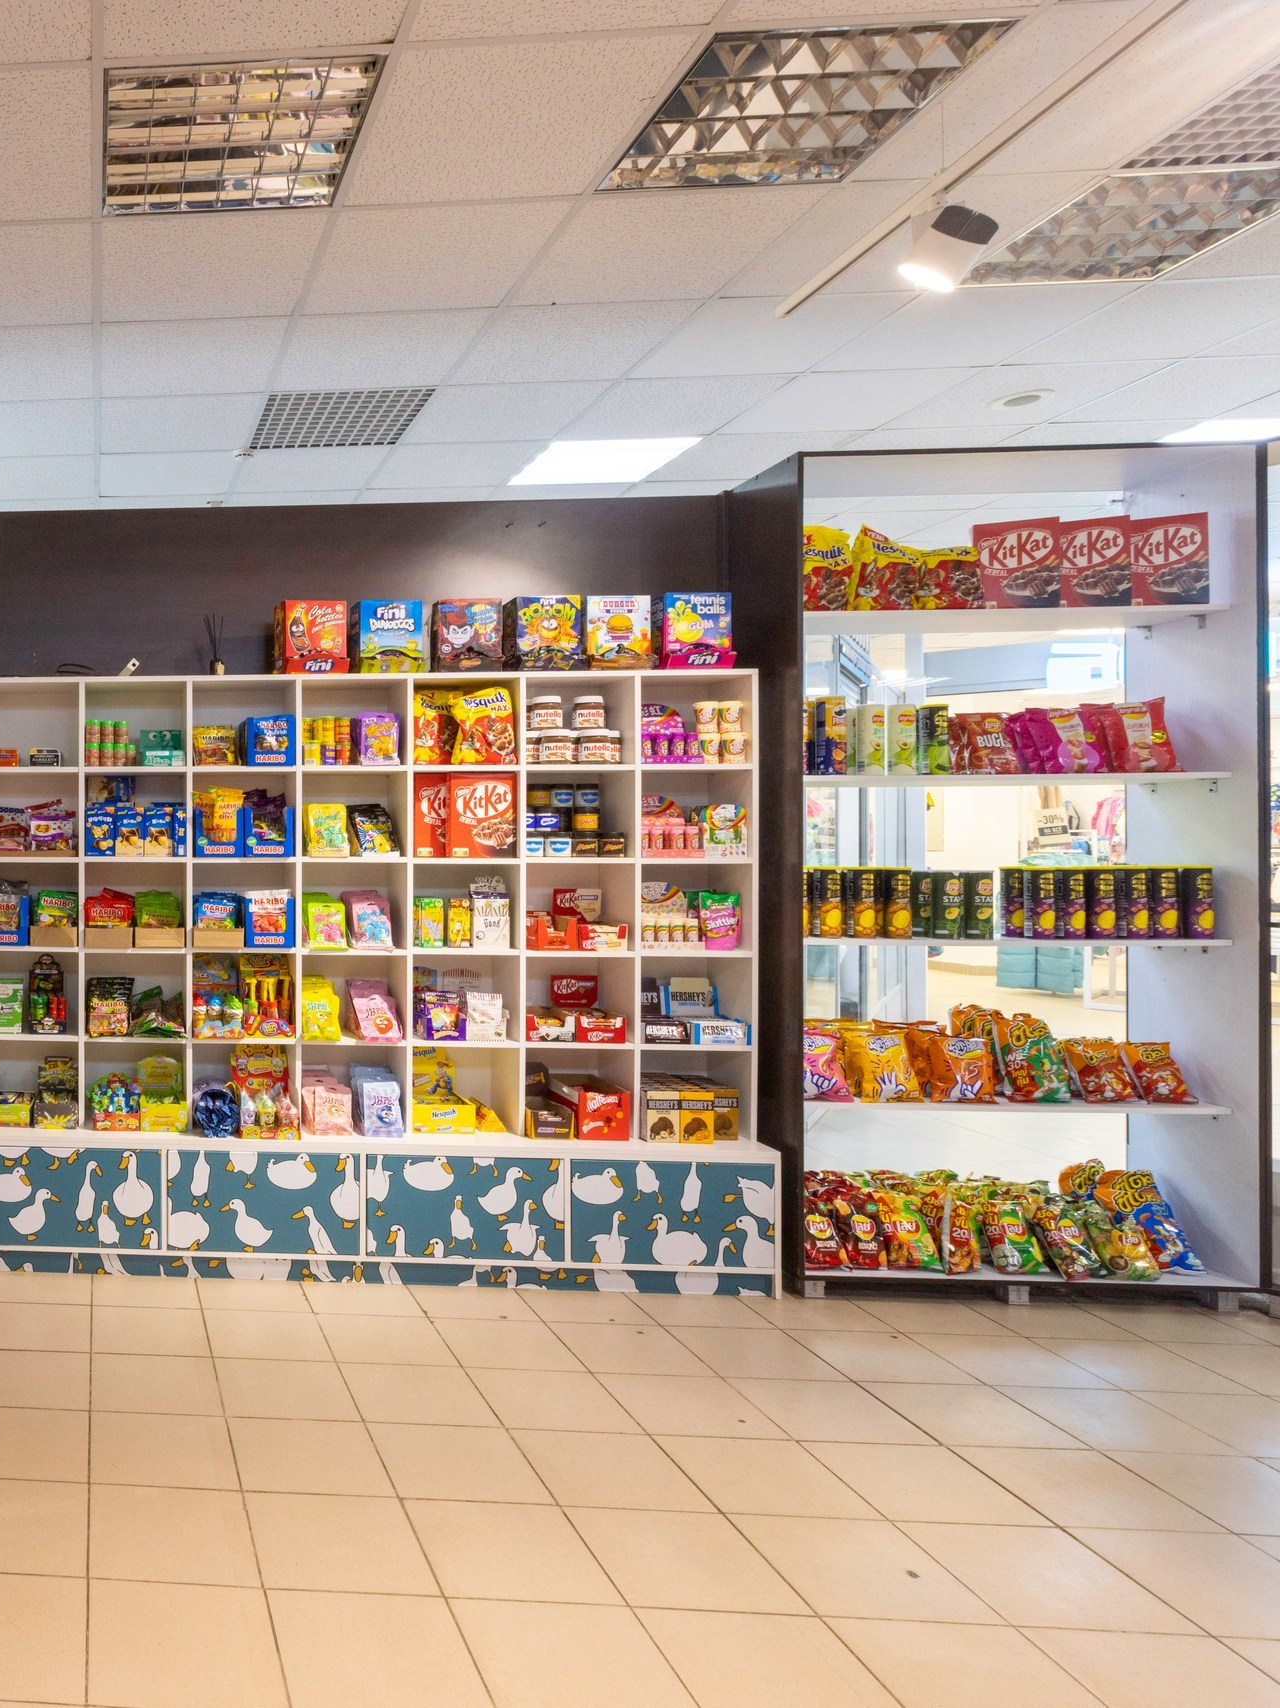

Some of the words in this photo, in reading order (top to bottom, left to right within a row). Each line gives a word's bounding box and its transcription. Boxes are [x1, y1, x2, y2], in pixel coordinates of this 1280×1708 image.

[988, 531, 1050, 568] KitKat
[1134, 528, 1198, 564] KitKat
[984, 569, 1008, 577] CEREAL
[603, 600, 636, 608] BURGER
[690, 595, 726, 605] tennis
[307, 605, 333, 620] Cola
[376, 606, 406, 619] Fini
[697, 604, 726, 614] balls
[688, 620, 714, 630] GUM
[687, 652, 719, 665] Fini
[305, 659, 333, 671] Fini
[535, 710, 562, 719] nutella
[577, 710, 604, 719] nutella
[259, 721, 288, 729] HARIBO
[544, 744, 571, 753] nutella
[583, 744, 612, 753] nutella
[255, 754, 286, 763] HARIBO
[463, 784, 509, 817] KitKat
[424, 816, 442, 825] CEREAL
[459, 816, 478, 826] CEREAL
[1038, 814, 1064, 824] -30%
[204, 846, 235, 854] HARIBO
[253, 846, 285, 854] HARIBO
[42, 898, 74, 907] HARIBO
[253, 898, 285, 906] HARIBO
[559, 893, 581, 907] KitKat
[91, 908, 124, 916] HARIBO
[203, 904, 234, 913] HARIBO
[555, 979, 577, 994] KitKat
[671, 992, 705, 1001] HERSHEY'S
[646, 1025, 677, 1035] HERSHEY'S
[1007, 1061, 1027, 1070] 30%
[1012, 1068, 1027, 1077] ใหญ่
[1017, 1075, 1029, 1086] คุ้ม
[648, 1100, 678, 1109] HERSHEY'S
[682, 1101, 712, 1110] HERSHEY'S
[432, 1108, 457, 1119] Nesquik
[809, 1217, 829, 1233] เลย์
[855, 1219, 871, 1233] เลย์
[1004, 1223, 1024, 1236] เลย์
[1061, 1225, 1078, 1240] เลย์
